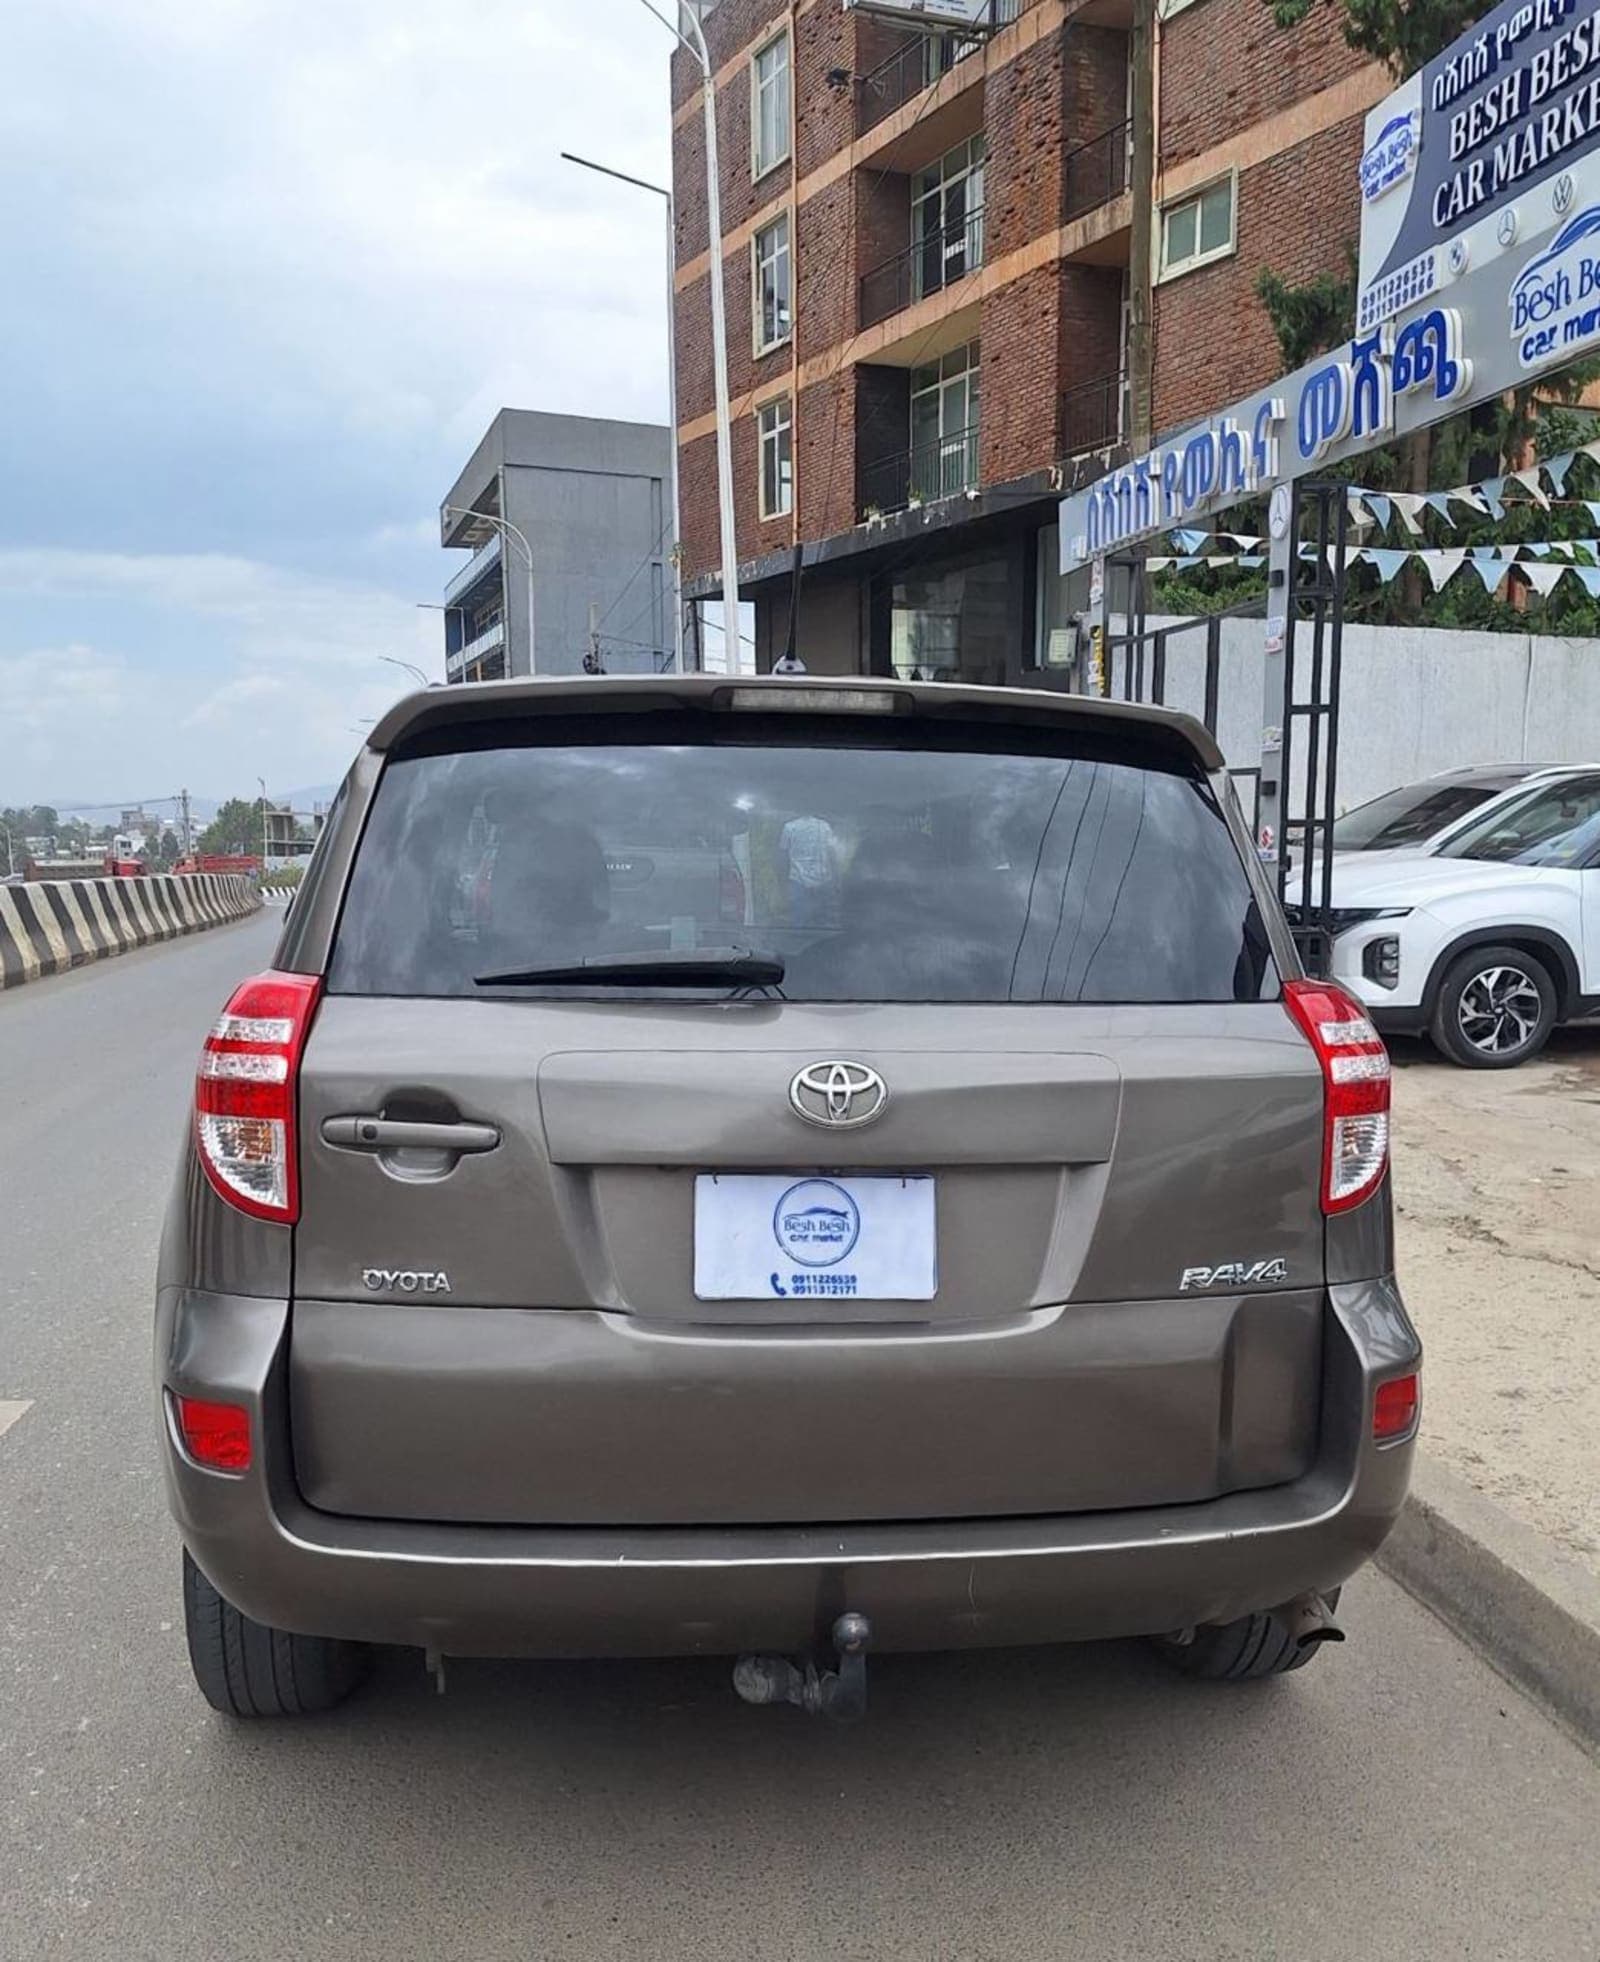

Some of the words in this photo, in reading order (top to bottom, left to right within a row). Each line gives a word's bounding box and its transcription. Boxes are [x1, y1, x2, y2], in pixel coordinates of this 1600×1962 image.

[1449, 68, 1522, 161] BESH
[1432, 159, 1485, 228] CAR
[1361, 255, 1434, 311] 0911226539
[1514, 268, 1571, 330] Besh
[1522, 324, 1557, 361] car
[784, 1219, 816, 1232] Besh
[819, 1219, 850, 1232] Besh
[1179, 1258, 1287, 1290] RAV4
